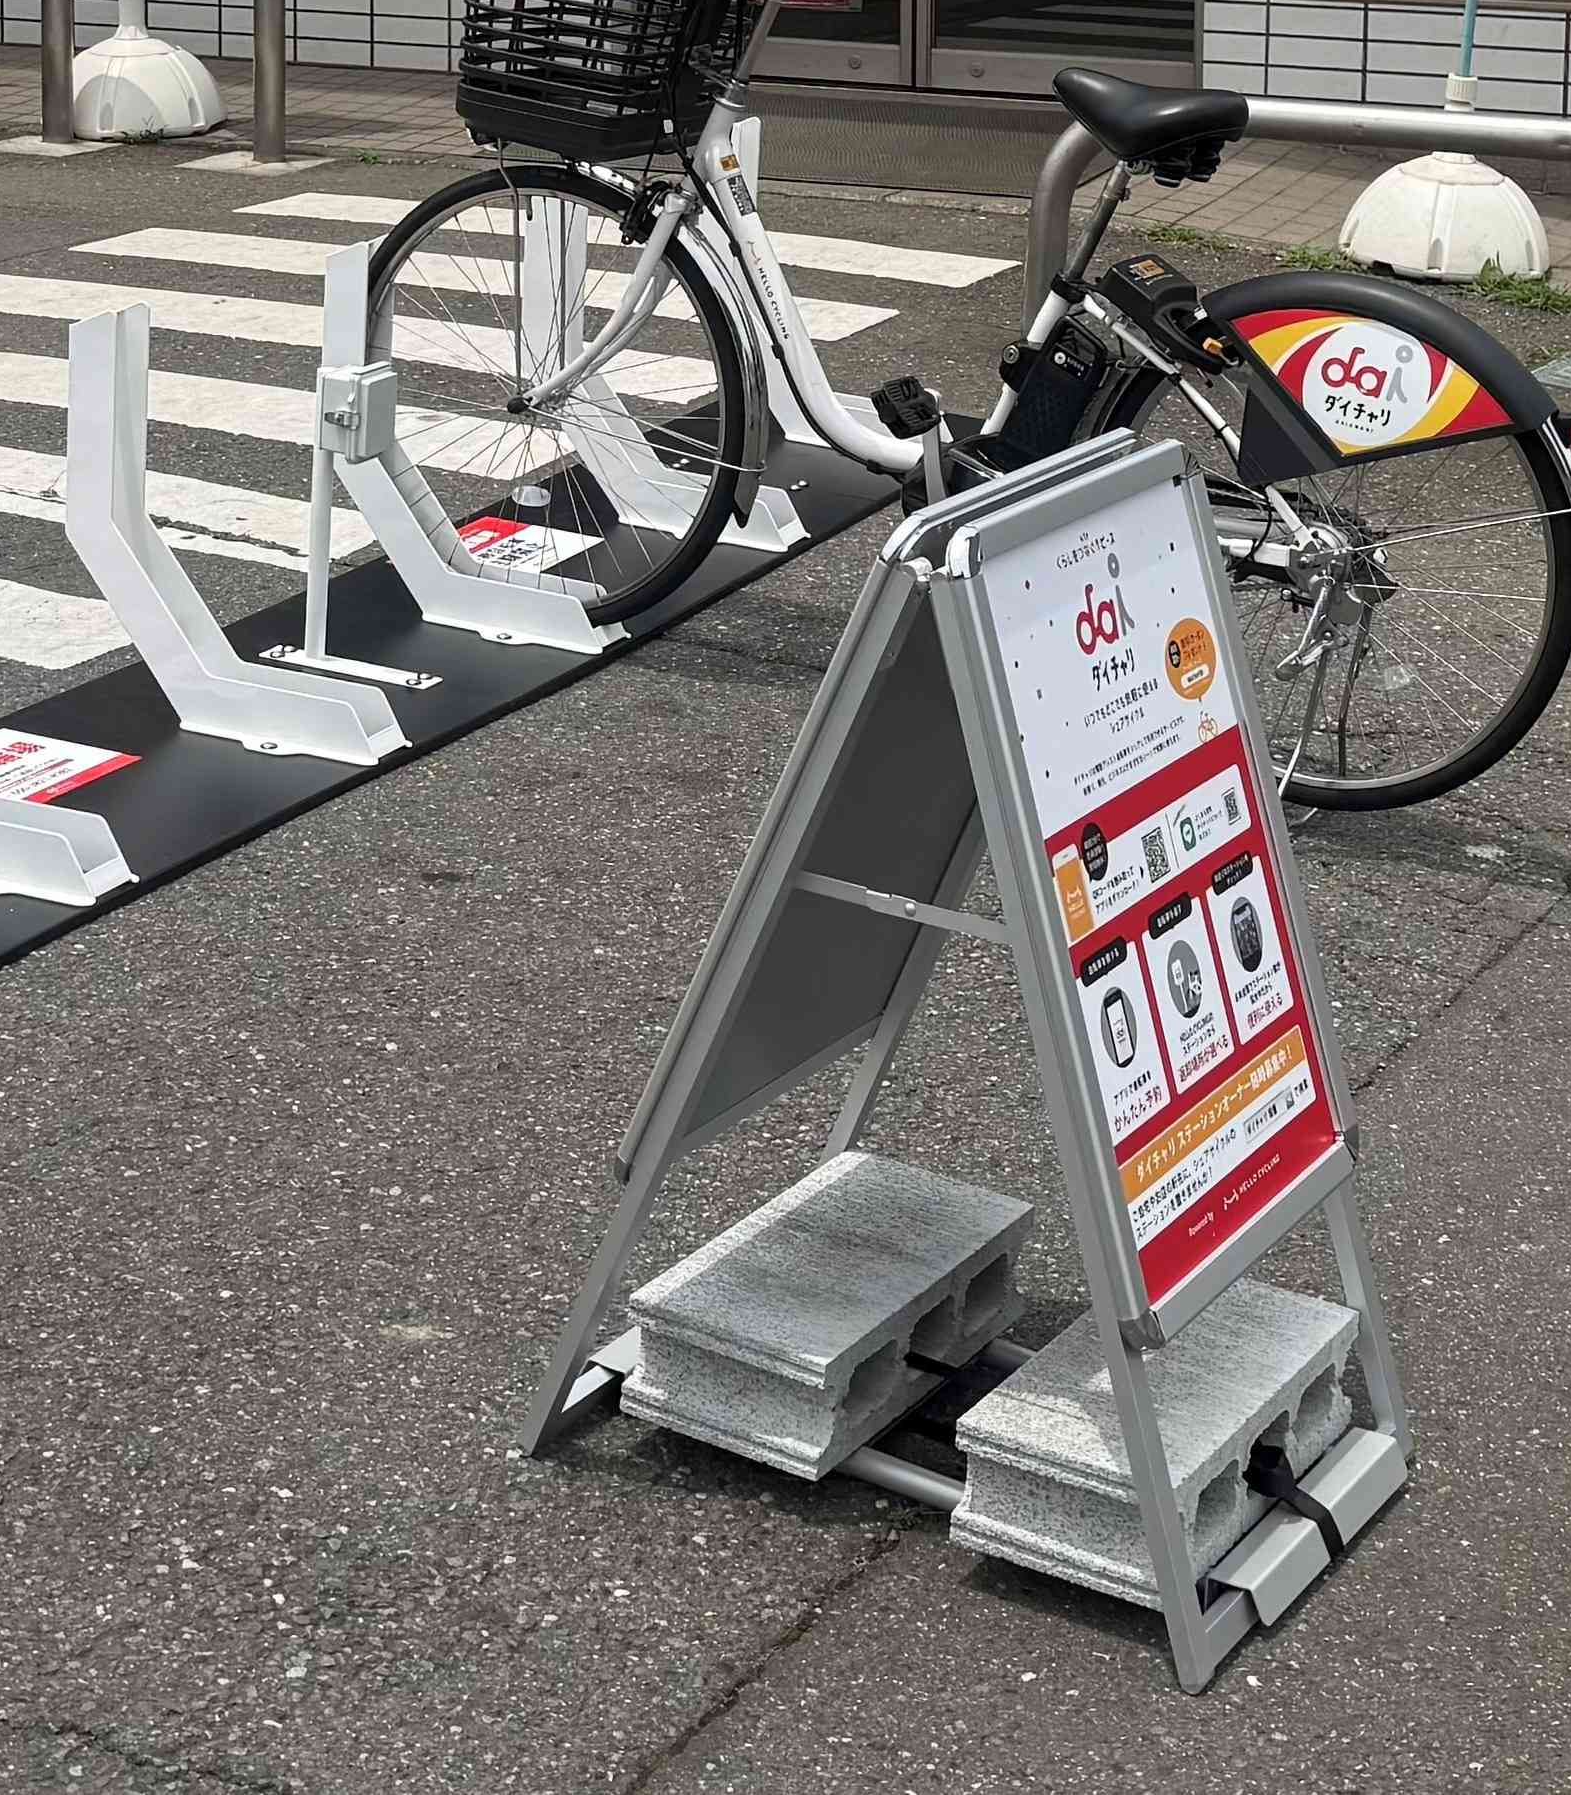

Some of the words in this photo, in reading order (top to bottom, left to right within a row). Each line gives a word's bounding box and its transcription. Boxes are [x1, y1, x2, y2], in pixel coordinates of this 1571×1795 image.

[757, 267, 774, 298] HELLO
[1324, 394, 1392, 427] ダイチャリ
[1091, 647, 1136, 692] ダイチャリ
[1113, 1081, 1163, 1135] かんたん予約
[1135, 1135, 1177, 1184] ダイチャリ
